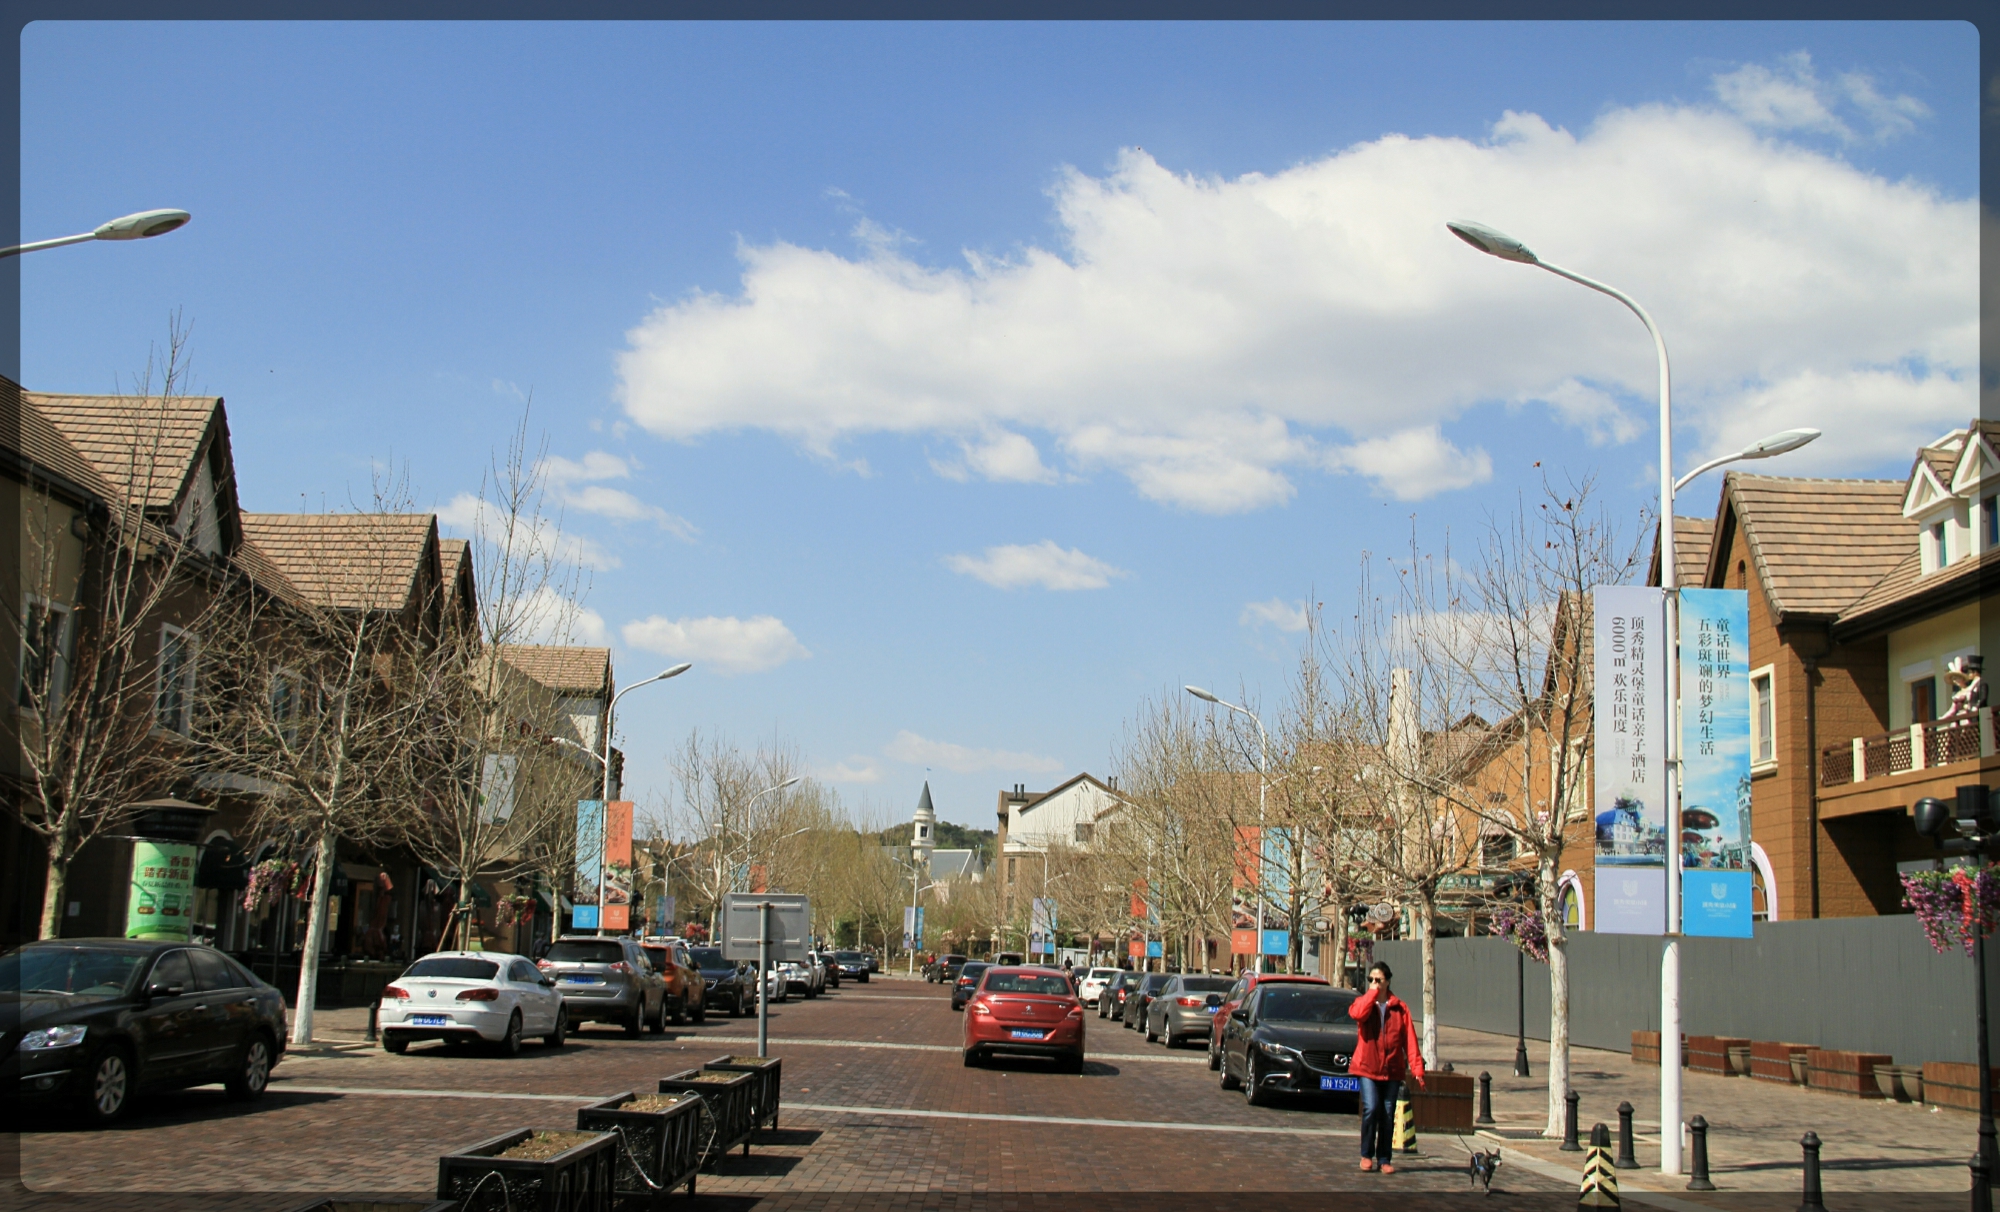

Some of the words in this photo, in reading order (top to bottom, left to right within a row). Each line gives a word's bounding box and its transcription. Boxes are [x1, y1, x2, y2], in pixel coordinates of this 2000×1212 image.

[1698, 618, 1714, 756] 五彩斑斓的梦幻生活
[1716, 618, 1731, 679] 童话世界
[1613, 672, 1628, 734] 欢乐国度
[1630, 615, 1646, 784] 顶秀精灵堡童话亲子酒店
